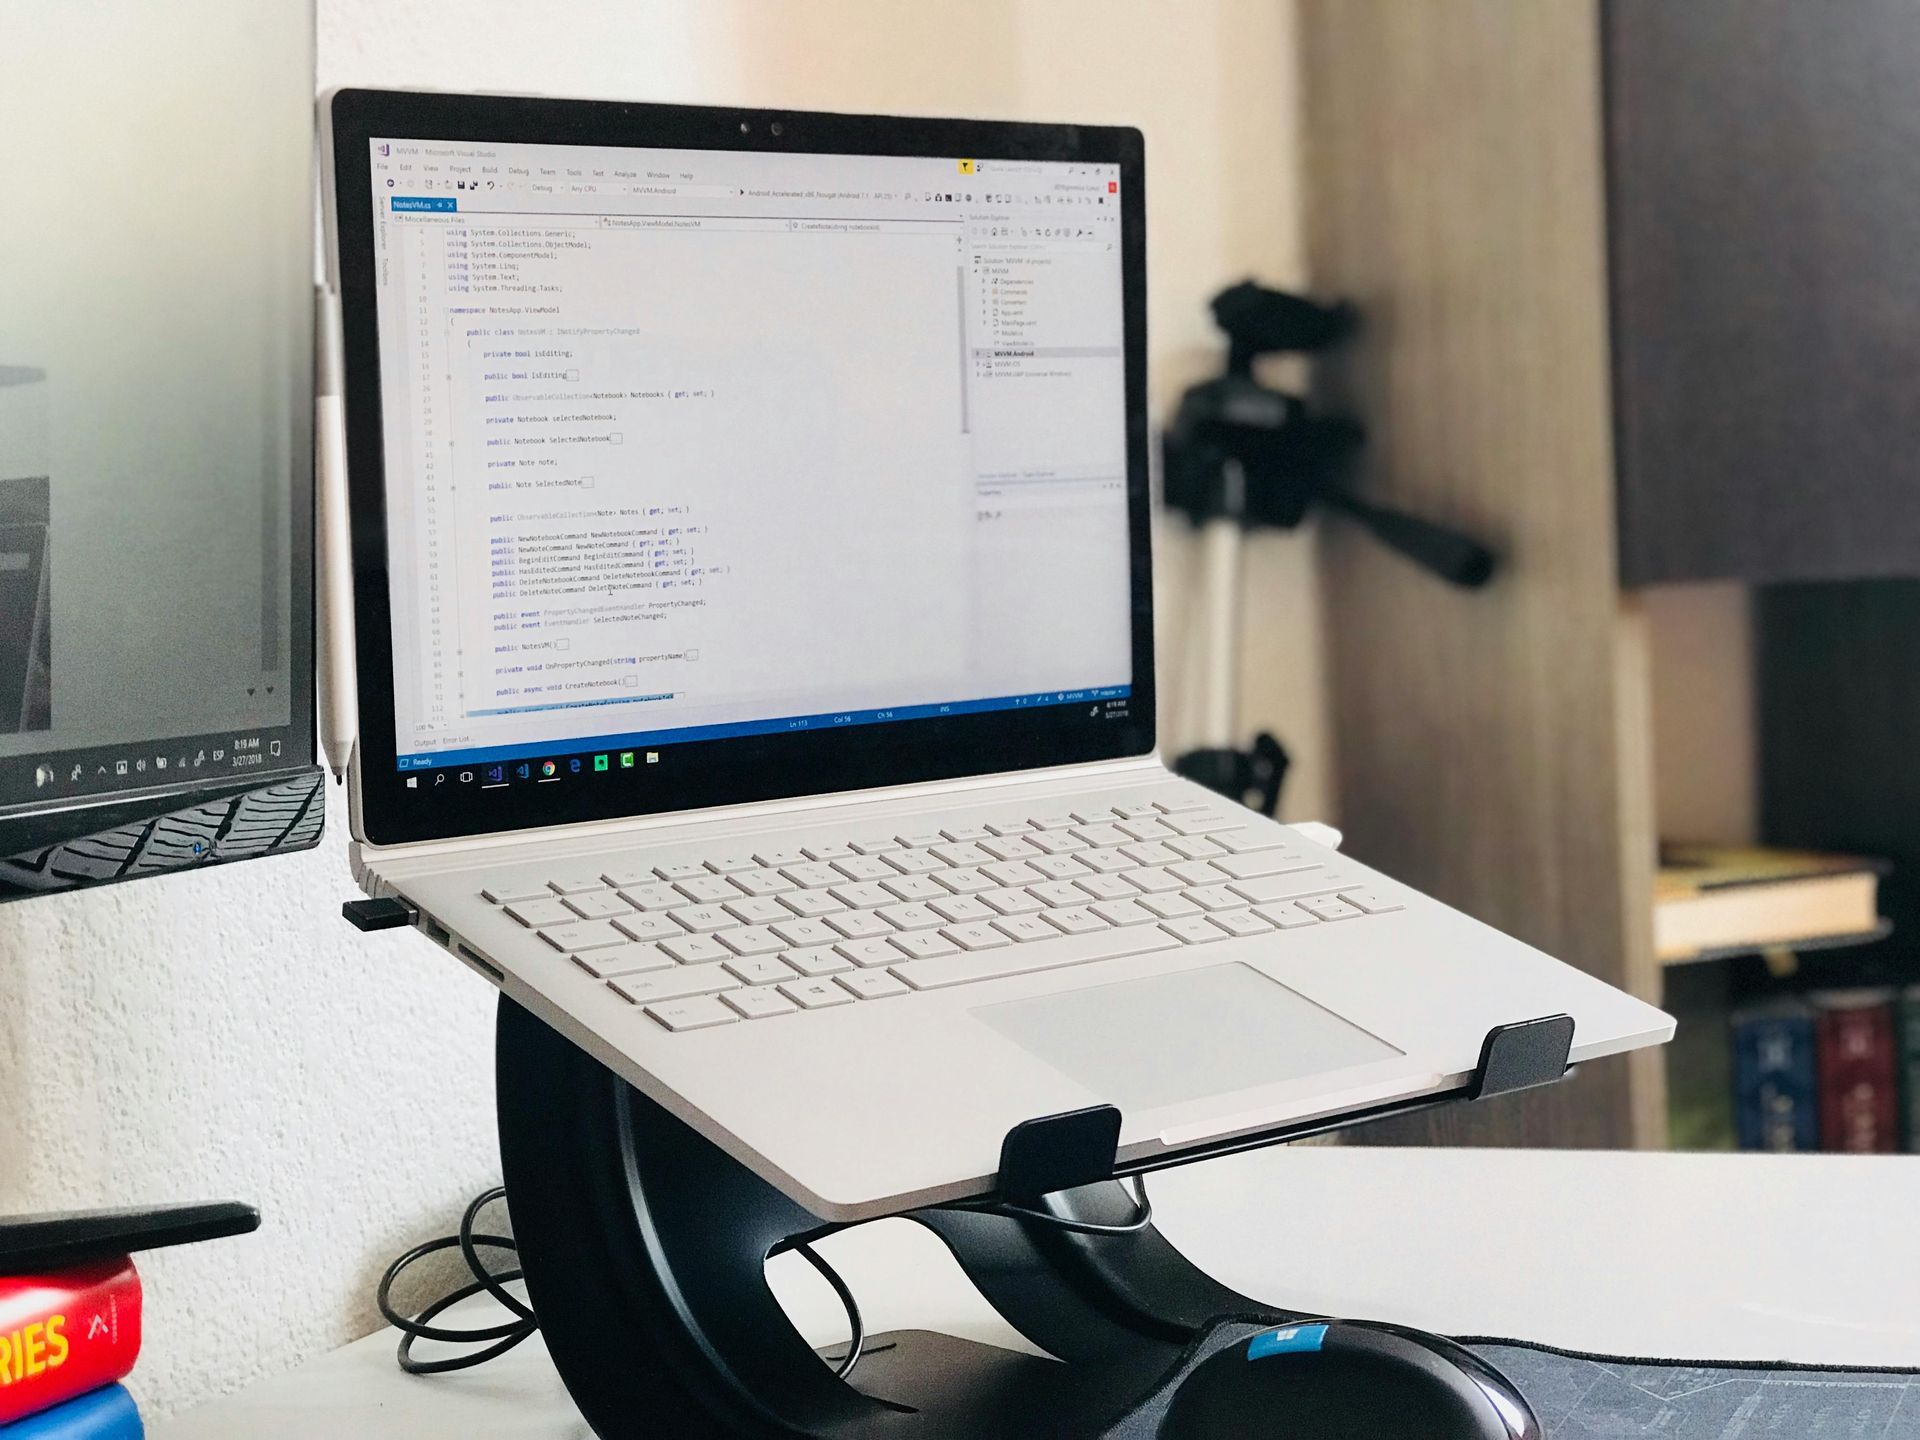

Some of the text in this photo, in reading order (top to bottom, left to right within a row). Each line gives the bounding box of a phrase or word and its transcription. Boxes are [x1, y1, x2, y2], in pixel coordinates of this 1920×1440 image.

[400, 164, 412, 172] Edit
[450, 165, 472, 175] Project
[482, 166, 498, 174] Build
[509, 167, 529, 176] Debug
[540, 168, 556, 176] Team
[566, 169, 582, 177] Tools
[614, 171, 637, 179] Analyze
[680, 172, 694, 181] Help
[532, 184, 553, 193] Debug
[571, 184, 597, 194] Any CPU
[393, 201, 431, 209] NotesVM.cs
[447, 230, 467, 238] using
[447, 241, 468, 249] using
[448, 252, 468, 260] using
[448, 263, 468, 271] using
[449, 274, 469, 282] using
[449, 285, 469, 293] using
[450, 307, 486, 315] namespace
[467, 328, 490, 337] public
[495, 328, 514, 336] class
[484, 350, 512, 359] private
[515, 350, 531, 358] bool
[485, 373, 508, 381] public
[485, 394, 509, 402] public
[630, 391, 664, 399] Notebooks
[674, 391, 689, 399] get;
[486, 416, 514, 424] private
[518, 415, 548, 423] Notebook
[487, 438, 510, 446] public
[514, 437, 545, 445] Notebook
[488, 460, 515, 468] private
[519, 459, 535, 467] Note
[489, 482, 512, 490] public
[490, 514, 514, 523] public
[650, 508, 664, 516] get;
[490, 536, 514, 545] public
[668, 527, 682, 536] get;
[491, 547, 515, 556] public
[639, 539, 654, 548] get;
[491, 558, 515, 567] public
[654, 549, 669, 557] get;
[492, 569, 516, 577] public
[654, 559, 669, 568] get;
[492, 580, 516, 588] public
[691, 567, 705, 576] get;
[493, 591, 516, 600] public
[662, 579, 677, 588] get;
[493, 612, 517, 621] public
[494, 622, 517, 631] public
[521, 621, 541, 629] event
[495, 645, 518, 653] public
[495, 665, 523, 675] private
[527, 663, 542, 671] void
[496, 687, 520, 696] public
[524, 686, 543, 694] async
[546, 683, 562, 691] void
[834, 716, 843, 724] Col
[235, 738, 260, 750] 8:19 AM
[213, 749, 225, 761] ESP
[232, 753, 262, 767] 3/27/2018
[413, 758, 432, 766] Ready
